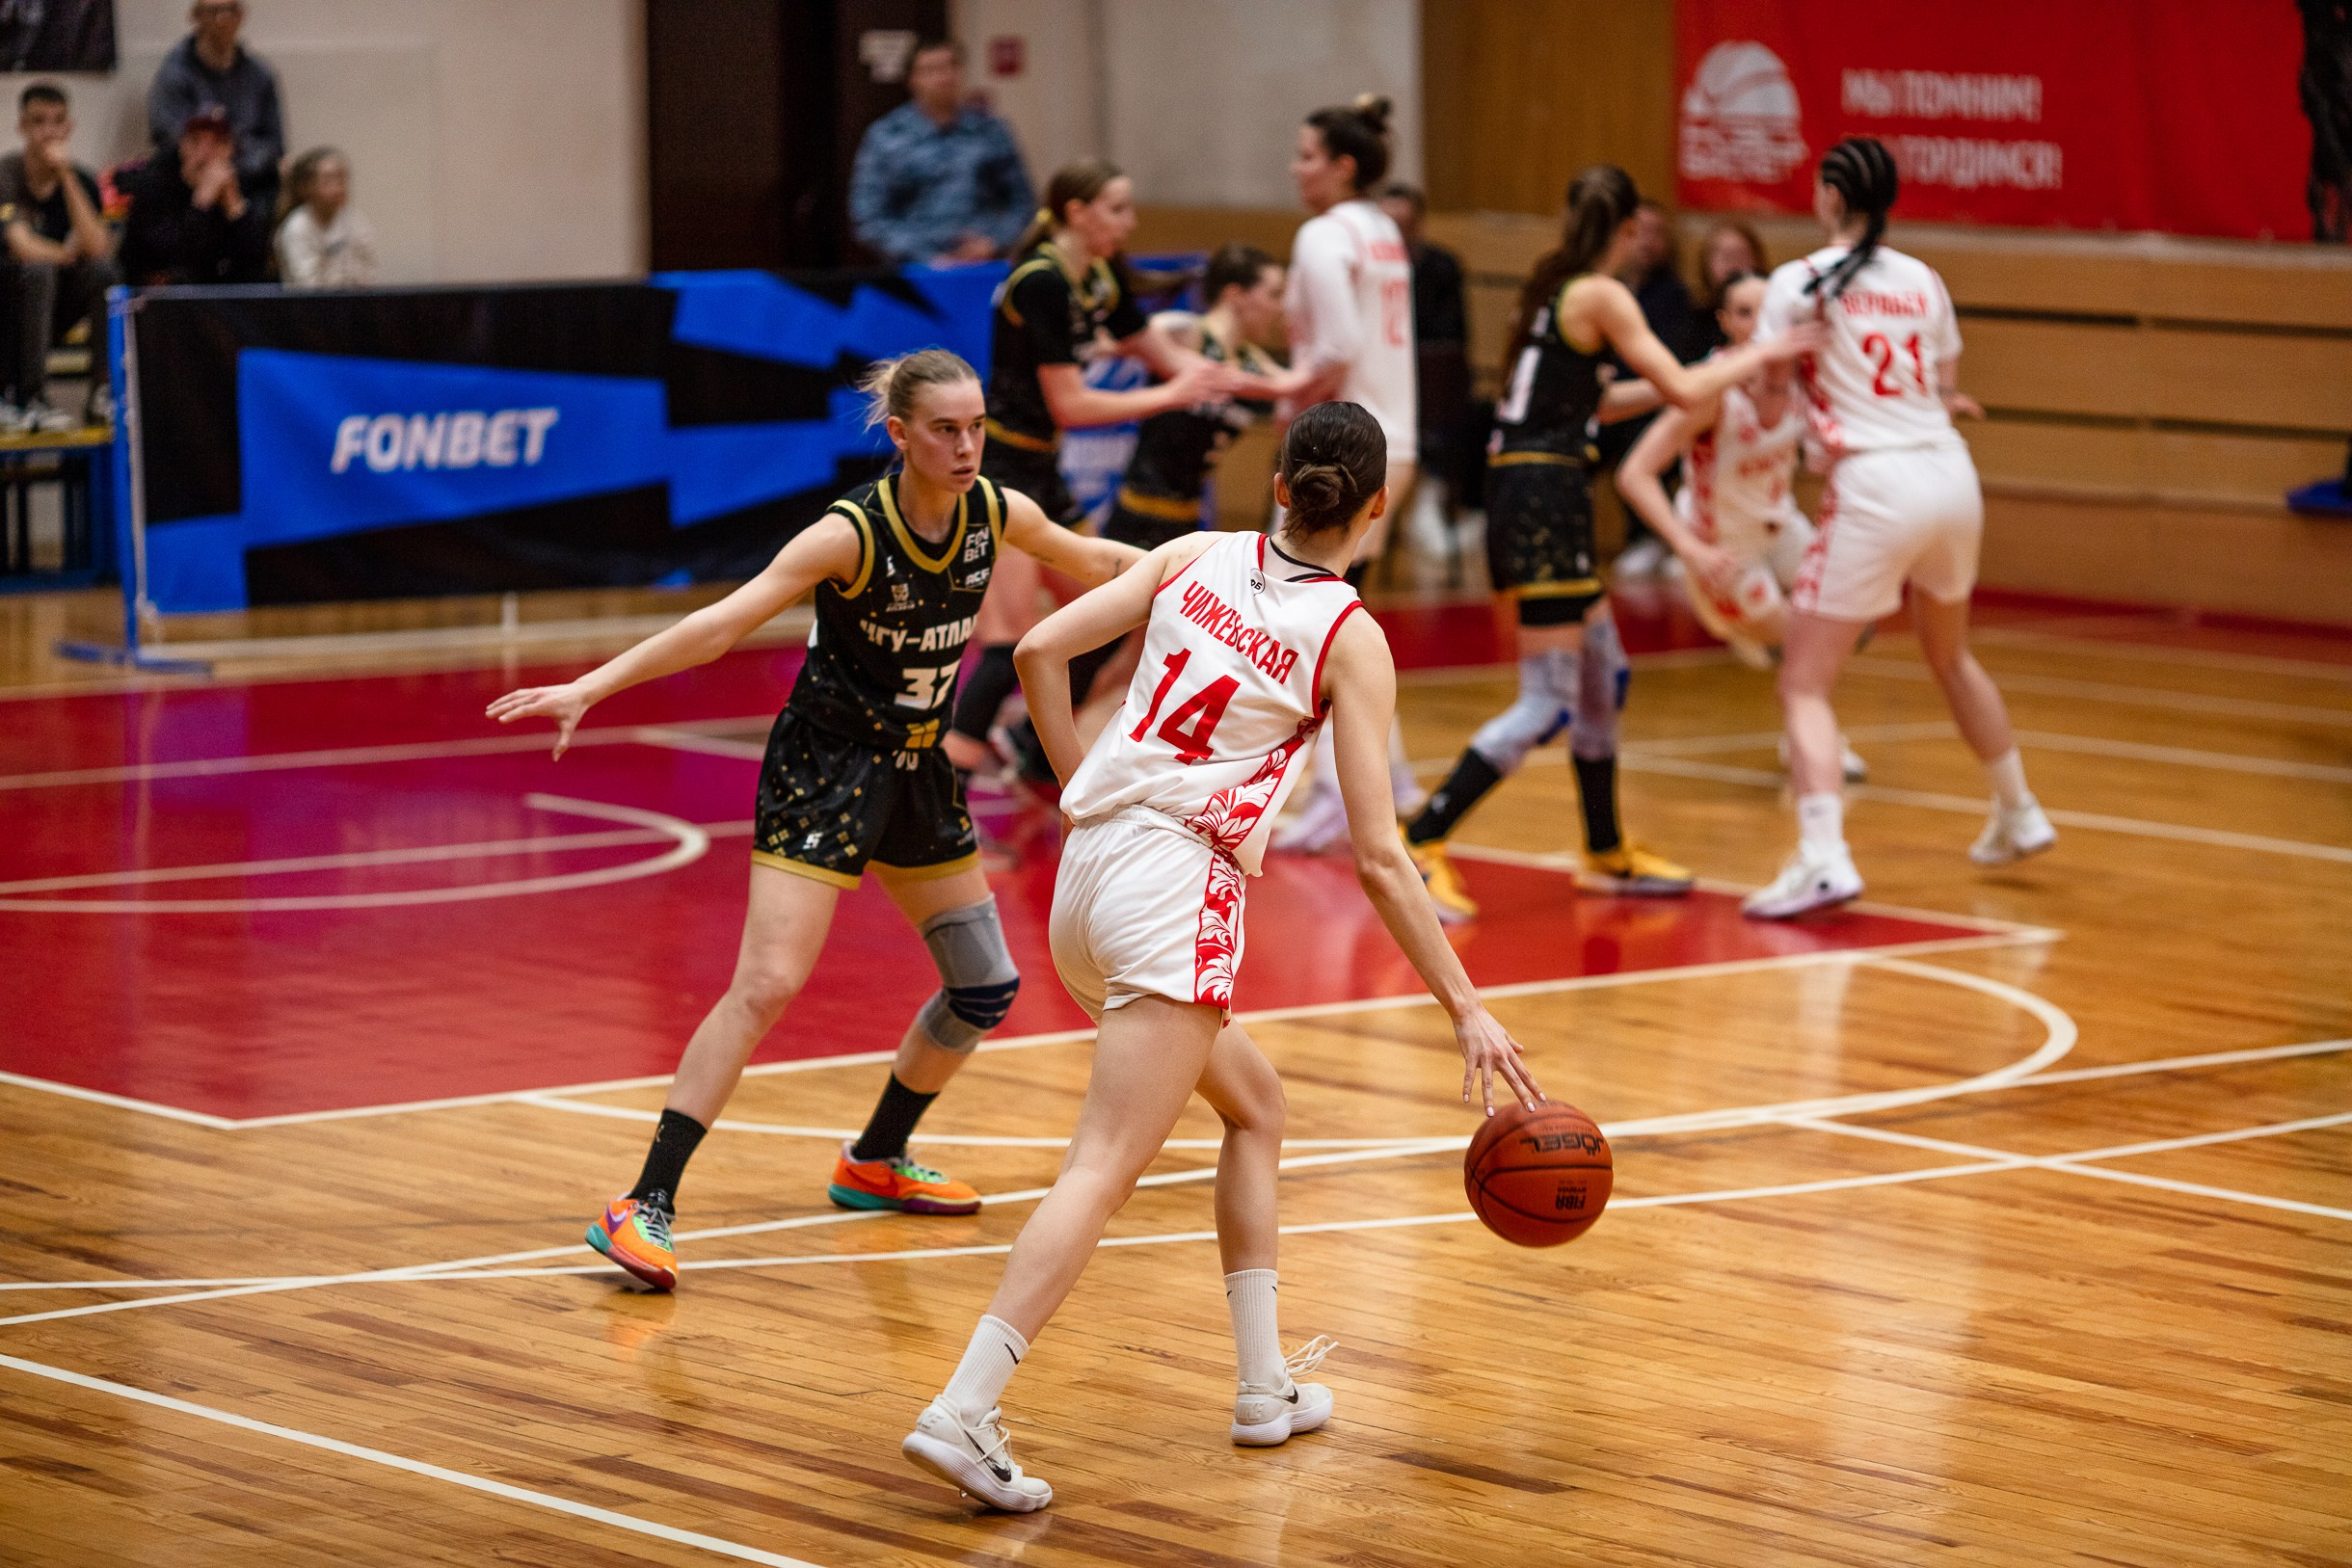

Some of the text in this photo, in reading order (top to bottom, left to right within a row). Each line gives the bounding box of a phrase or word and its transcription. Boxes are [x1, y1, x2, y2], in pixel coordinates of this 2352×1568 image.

[1862, 332, 1928, 397] 21
[331, 407, 560, 474] FONBET
[1180, 580, 1298, 684] ЧИЖЕВСКАЯ
[1128, 648, 1241, 765] 14
[1555, 1195, 1586, 1210] FIBA
